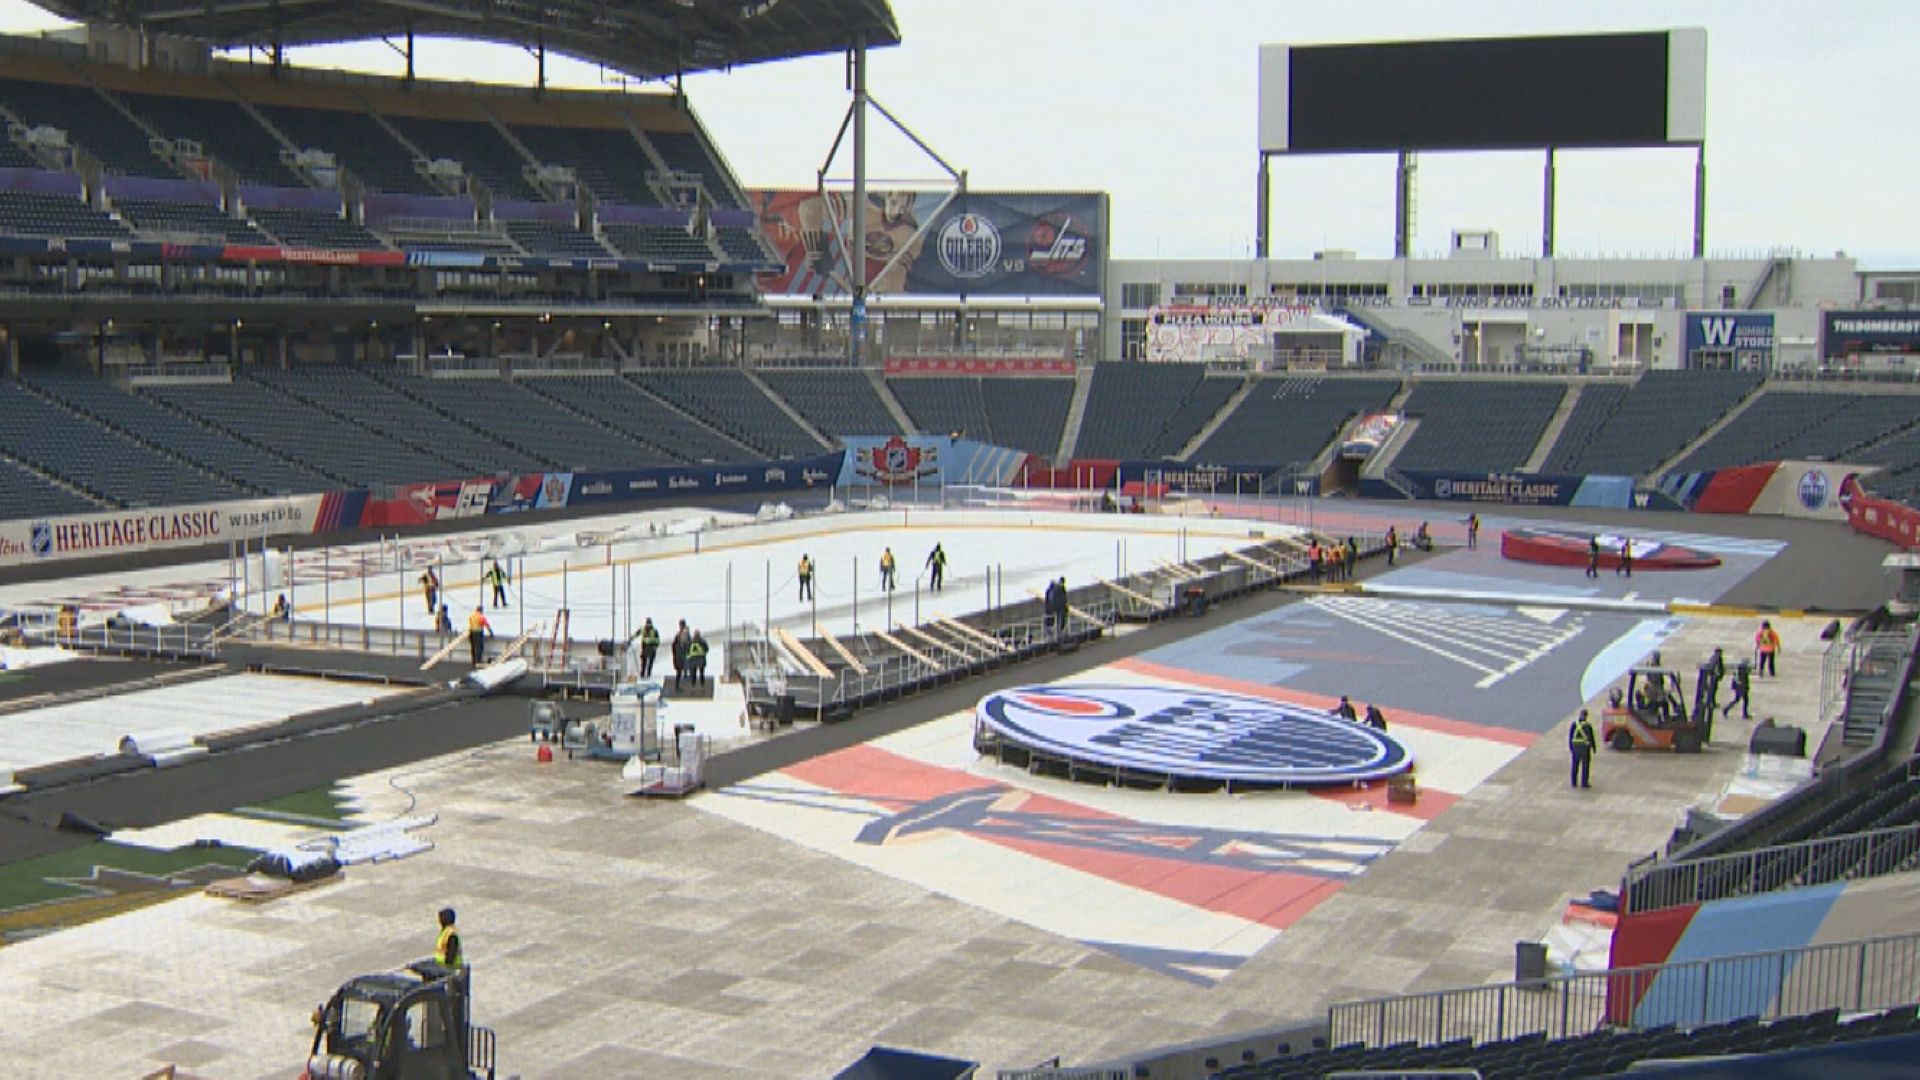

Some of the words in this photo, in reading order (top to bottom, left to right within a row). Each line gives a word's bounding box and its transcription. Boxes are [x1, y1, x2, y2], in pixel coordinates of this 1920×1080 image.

[1701, 316, 1735, 346] W
[1510, 483, 1558, 498] CLASSIC
[56, 517, 147, 552] HERITAGE
[149, 510, 221, 540] CLASSIC
